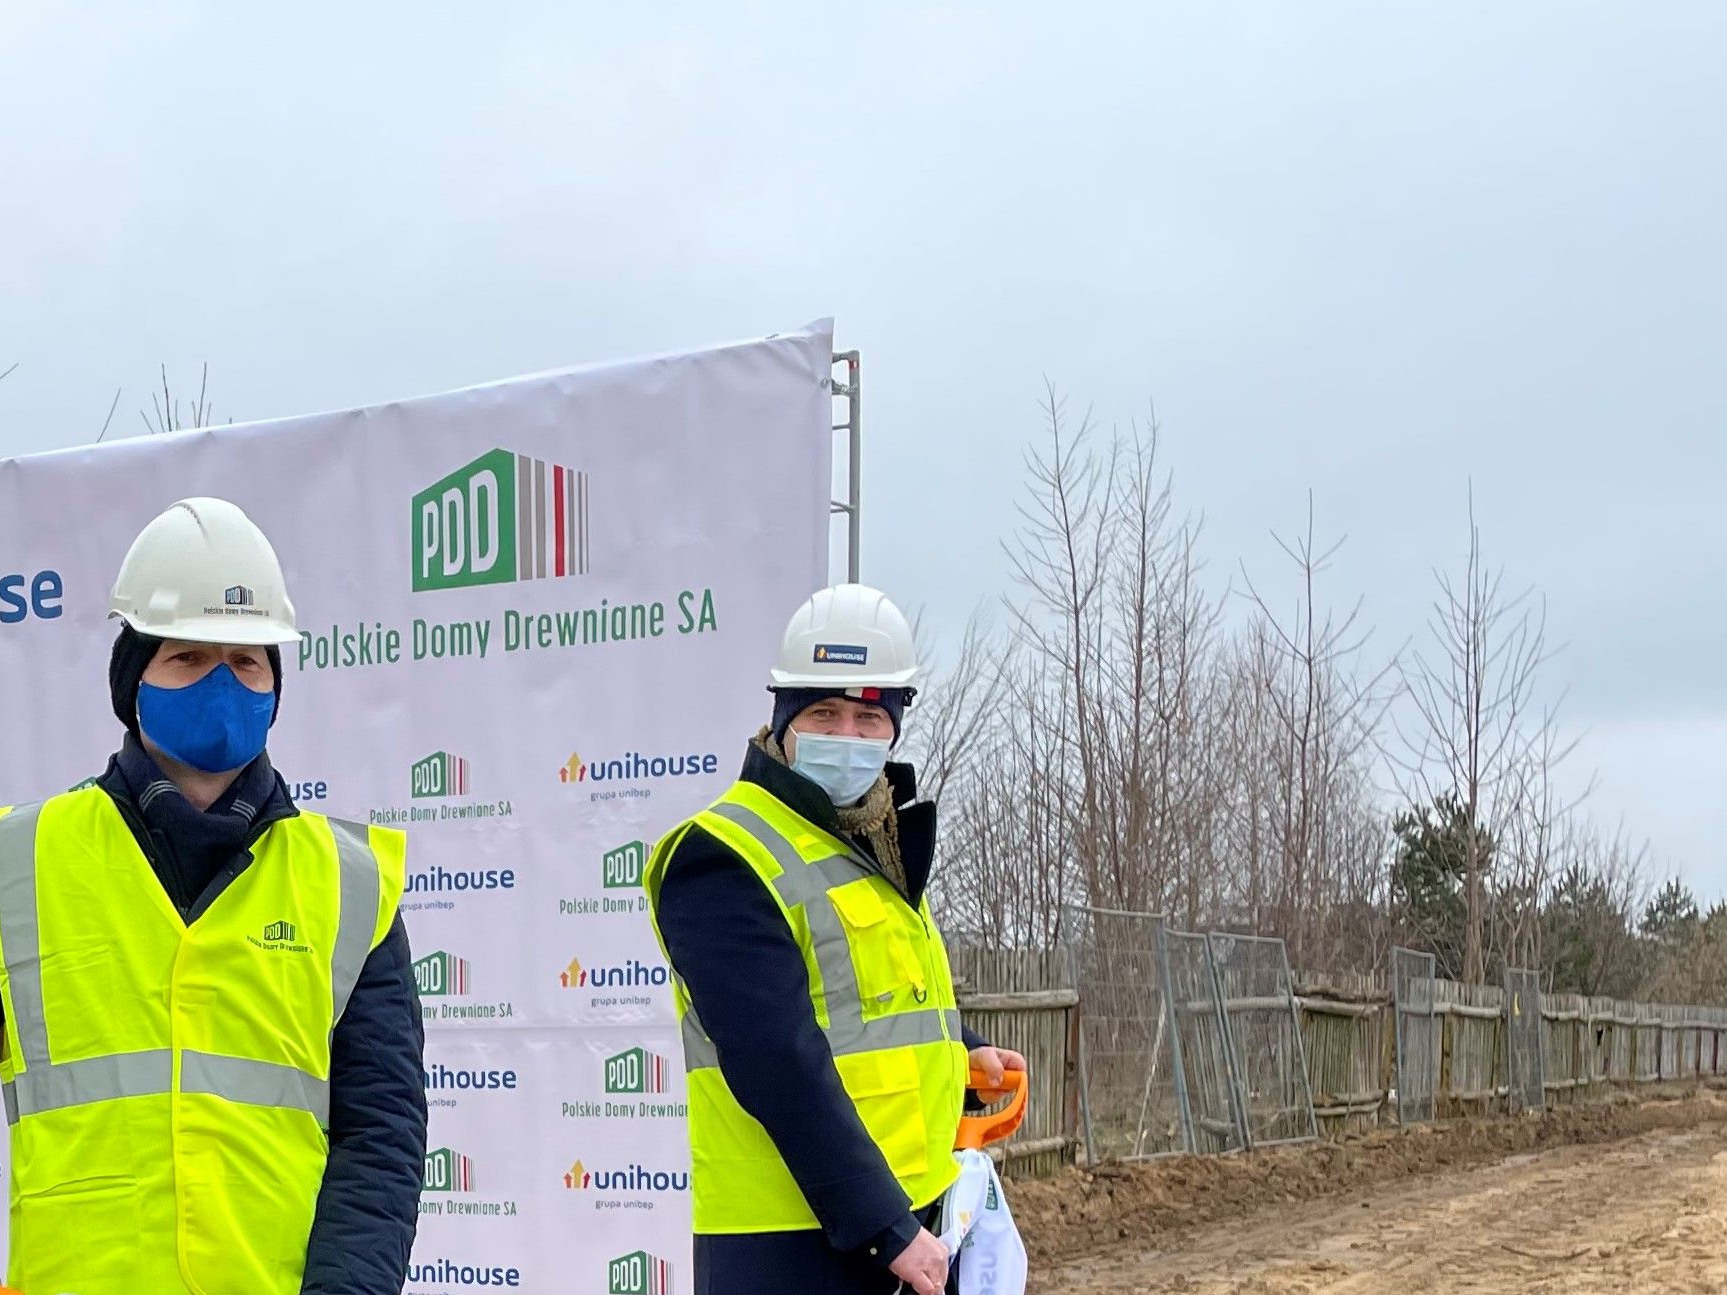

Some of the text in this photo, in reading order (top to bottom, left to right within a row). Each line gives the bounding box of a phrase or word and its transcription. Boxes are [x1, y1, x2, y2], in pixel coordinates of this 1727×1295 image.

[423, 469, 499, 579] PDD
[298, 588, 717, 672] Polskie Domy Drewniane SA
[414, 757, 442, 795] PDD
[590, 752, 718, 782] unihouse
[590, 788, 651, 801] grupa unibep
[369, 800, 513, 824] Polskie Domy Drewniane SA
[607, 846, 638, 885] PDD
[559, 897, 599, 915] Polskie
[602, 897, 633, 913] Domy
[590, 959, 673, 987] uniho
[441, 1003, 496, 1019] Drewniane
[499, 1002, 513, 1018] SA
[608, 1053, 639, 1090] PDD
[562, 1101, 688, 1119] Polskie Domy Drewnia
[424, 1153, 447, 1188] DD
[594, 1164, 691, 1191] unihou
[446, 1200, 501, 1216] Drewniane
[503, 1201, 517, 1216] SA
[405, 1258, 520, 1287] unihouse
[612, 1256, 642, 1292] PDD
